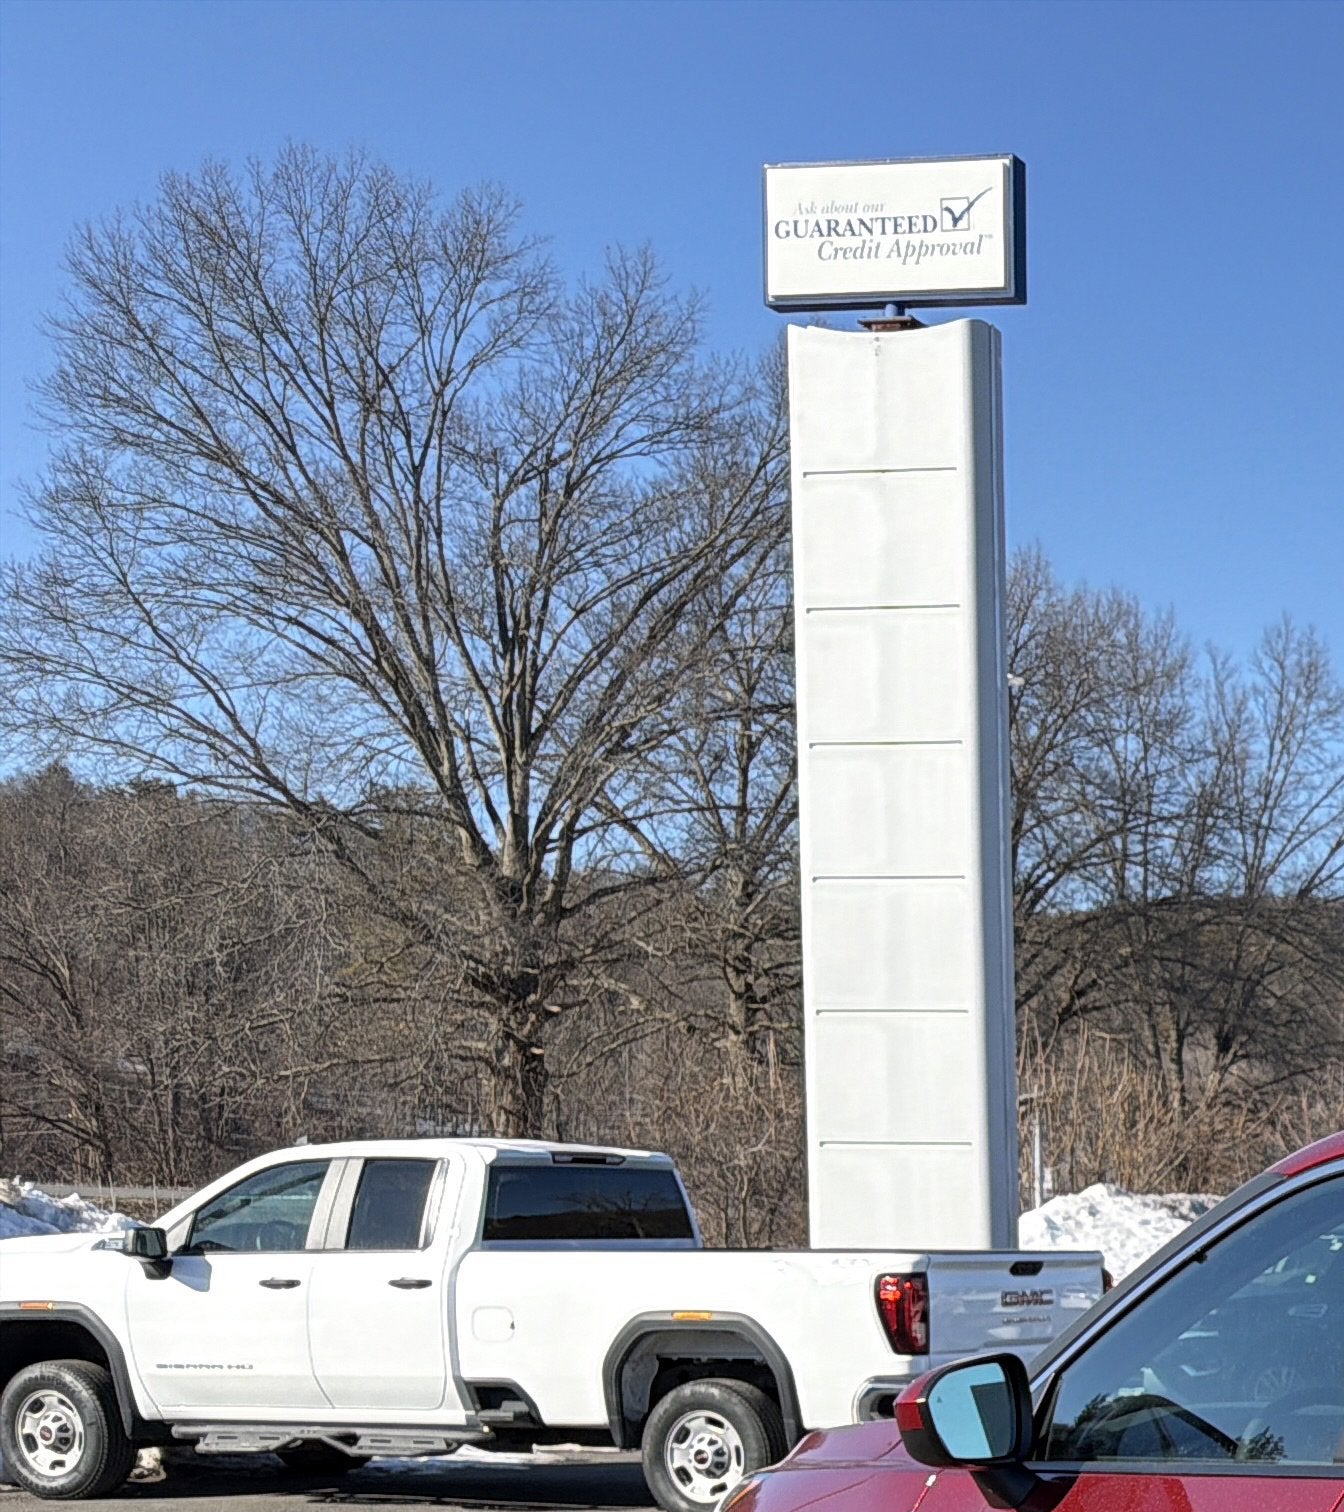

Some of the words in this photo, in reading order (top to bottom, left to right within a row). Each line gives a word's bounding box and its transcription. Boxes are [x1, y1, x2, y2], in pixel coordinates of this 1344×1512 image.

[794, 202, 817, 216] Ask
[821, 199, 859, 214] about
[862, 202, 886, 213] our
[774, 214, 938, 240] GUARANTEED
[817, 239, 881, 261] Credit
[1001, 1288, 1055, 1307] GMC
